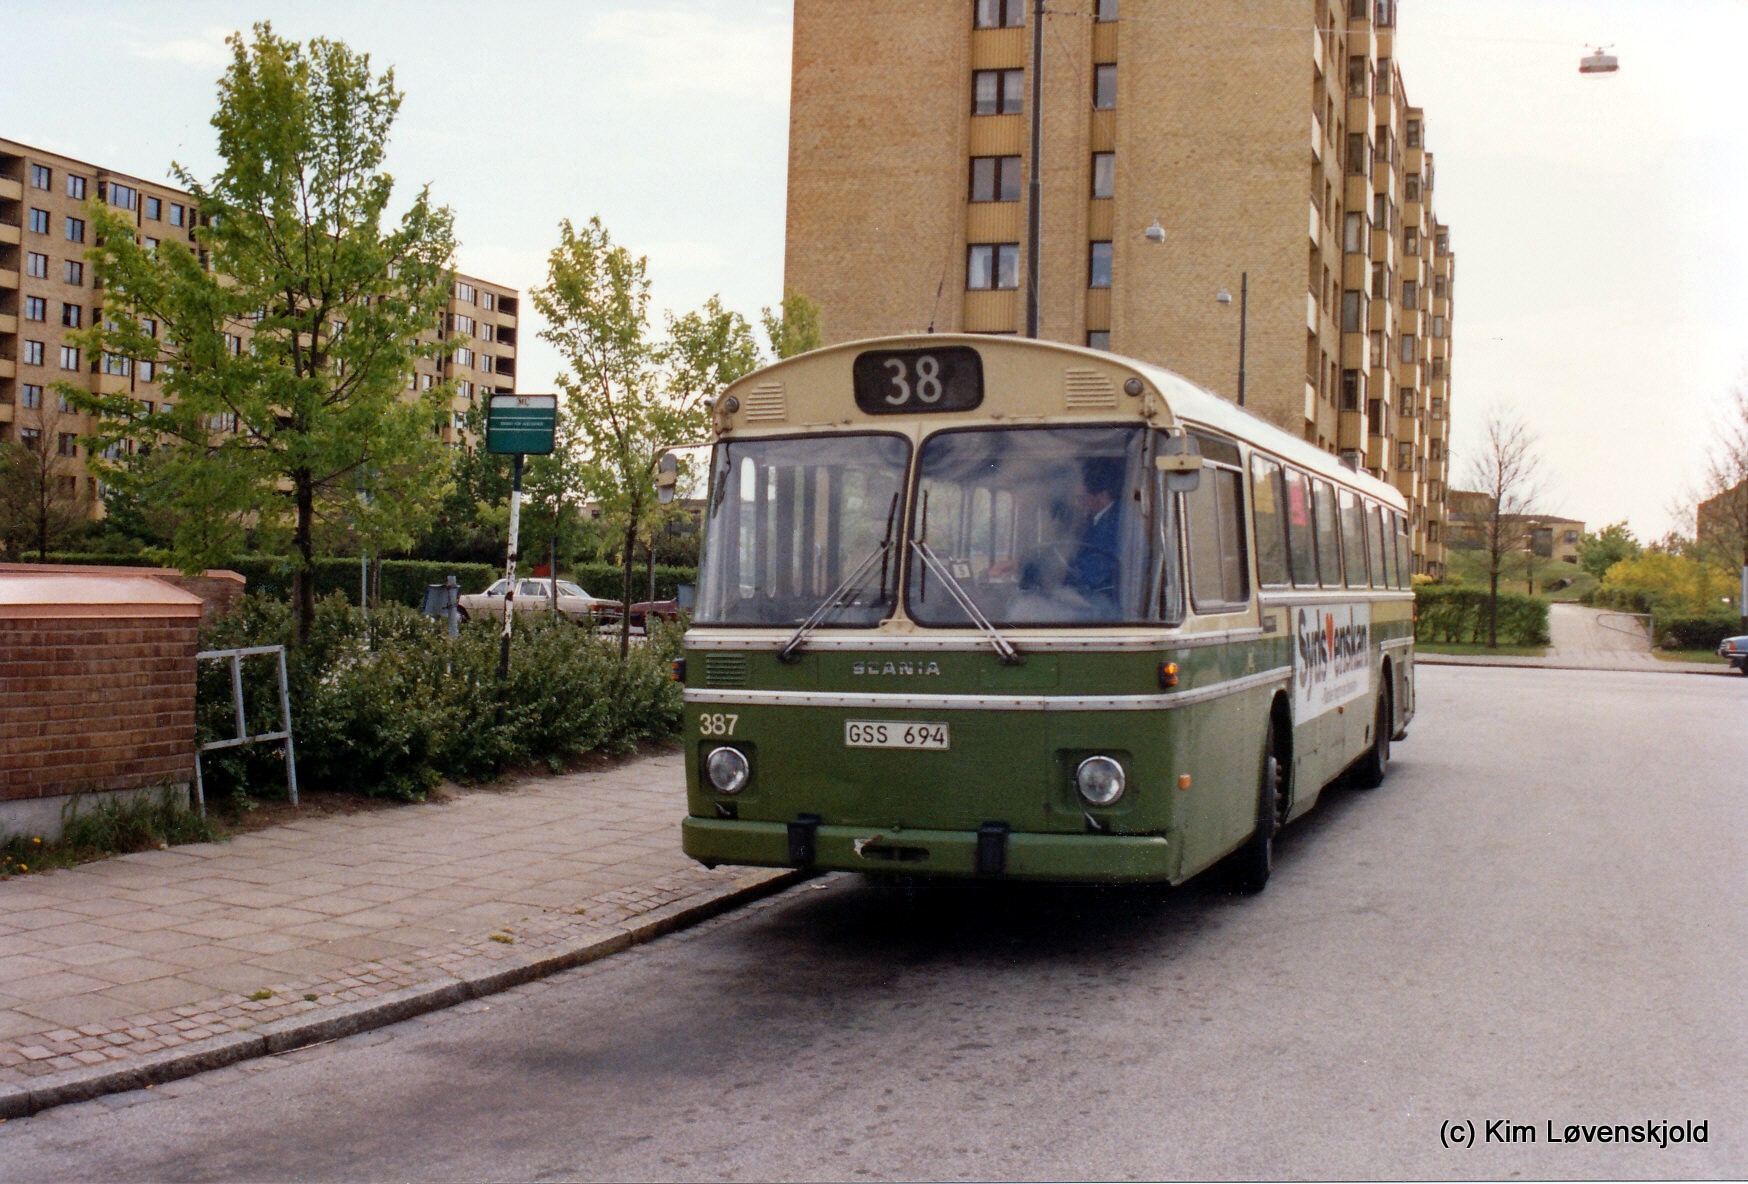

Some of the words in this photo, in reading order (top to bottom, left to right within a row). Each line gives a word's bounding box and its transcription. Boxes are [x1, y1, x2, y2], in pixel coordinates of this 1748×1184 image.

[883, 355, 943, 406] 38
[852, 661, 941, 676] SCANIA
[699, 713, 739, 736] 387
[849, 725, 888, 744] GSS
[903, 726, 945, 746] 694
